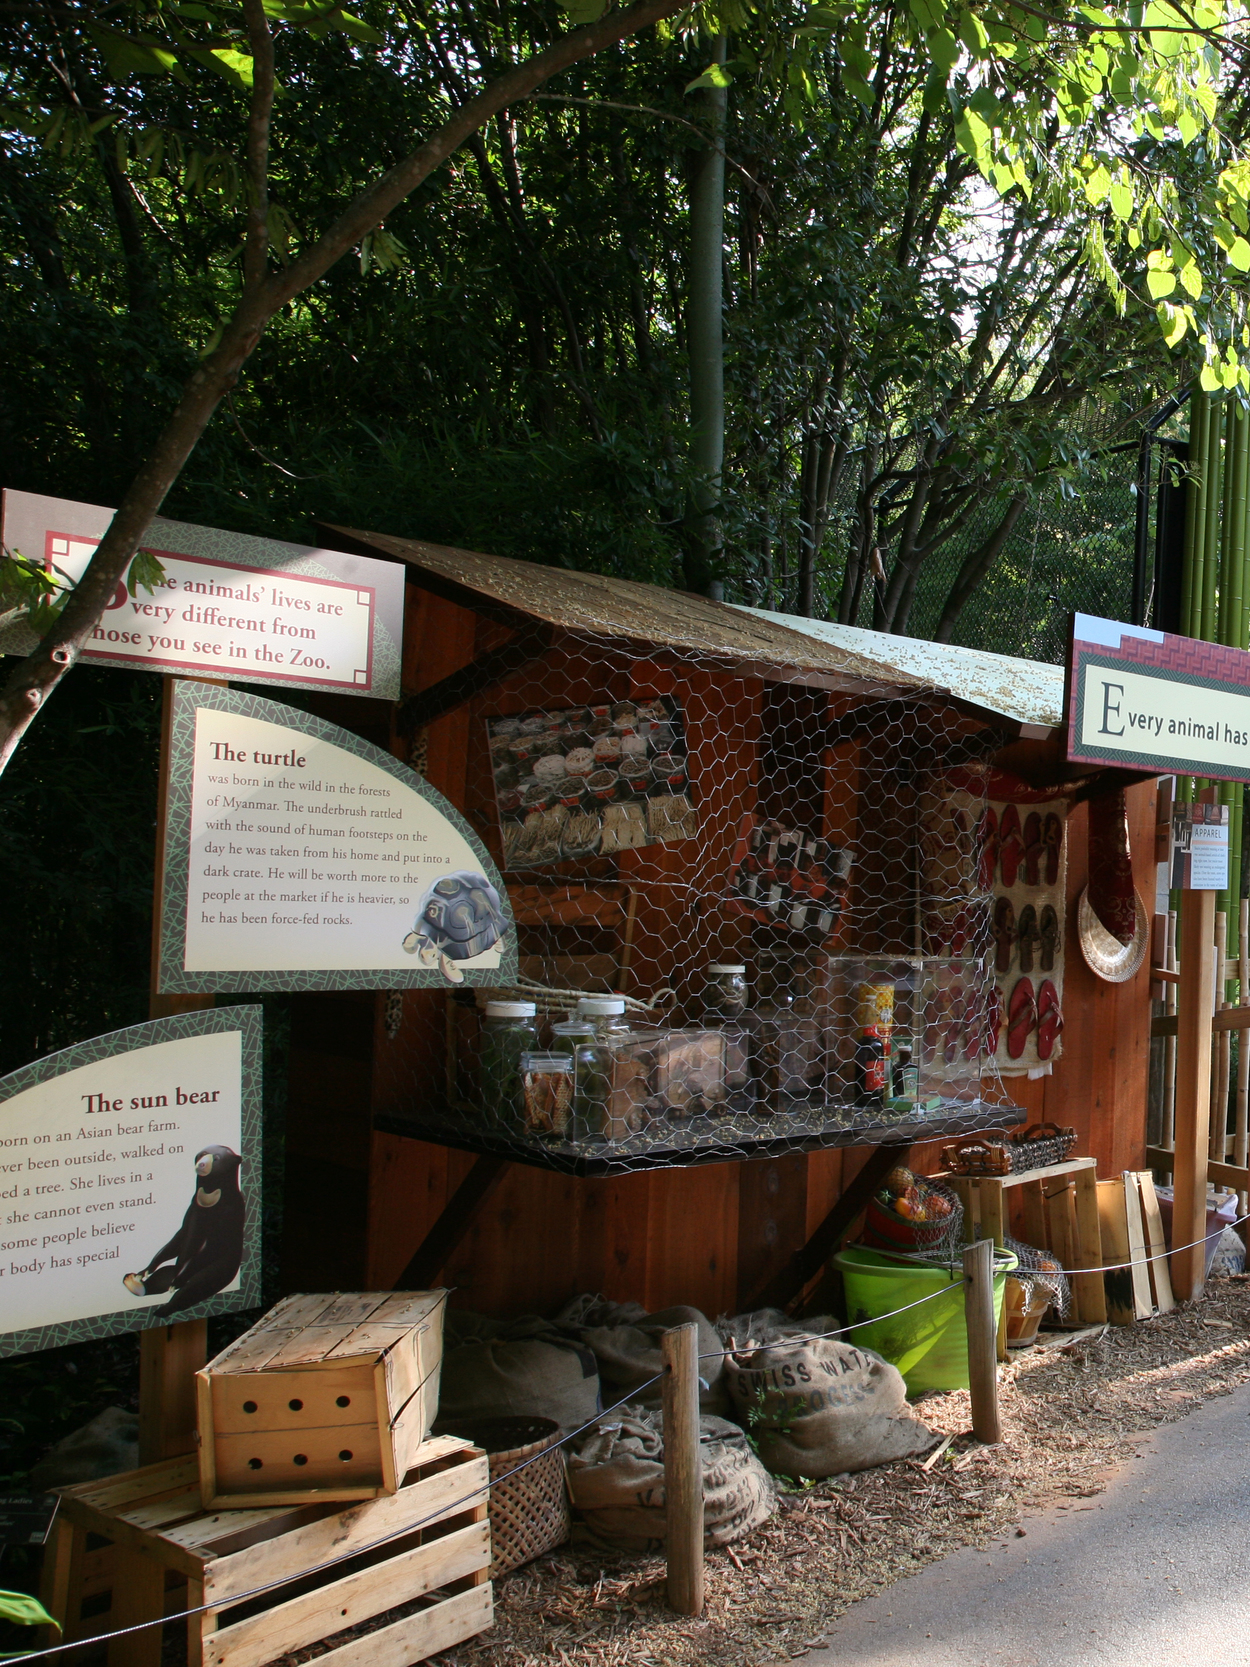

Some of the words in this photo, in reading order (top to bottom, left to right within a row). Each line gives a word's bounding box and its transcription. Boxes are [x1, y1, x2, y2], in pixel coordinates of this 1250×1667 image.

[272, 589, 310, 611] lives
[317, 603, 342, 616] are
[131, 601, 176, 624] very
[182, 604, 266, 632] different
[272, 617, 315, 639] from
[92, 624, 142, 645] hose
[148, 634, 186, 653] you
[193, 642, 221, 655] see
[229, 641, 247, 658] in
[255, 644, 283, 663] the
[290, 649, 330, 669] Zoo.
[1098, 682, 1163, 736] Every
[1168, 718, 1219, 741] animal
[1225, 724, 1247, 745] has
[209, 741, 247, 763] The
[252, 749, 307, 768] turtle
[207, 775, 229, 785] was
[232, 773, 260, 787] born
[263, 776, 275, 788] in
[278, 777, 296, 790] the
[298, 779, 322, 792] wild
[325, 781, 336, 793] in
[339, 782, 356, 795] the
[358, 783, 391, 798] forests
[206, 794, 221, 807] of
[222, 795, 280, 812] Myanmar.
[283, 800, 305, 813] The
[307, 802, 367, 817] underbrush
[370, 807, 403, 820] rattled
[205, 818, 232, 831] with
[235, 819, 254, 832] the
[256, 822, 291, 835] sound
[294, 823, 308, 835] of
[308, 823, 346, 838] human
[348, 826, 394, 843] footsteps
[396, 833, 409, 841] on
[412, 830, 428, 842] the
[1195, 828, 1221, 838] APPAREL
[204, 840, 226, 857] day
[228, 841, 243, 855] he
[245, 847, 267, 856] was
[269, 844, 300, 857] taken
[303, 845, 329, 859] from
[331, 847, 348, 860] his
[350, 848, 380, 861] home
[381, 850, 400, 862] and
[402, 854, 420, 866] put
[422, 855, 443, 864] into
[444, 856, 451, 864] a
[203, 864, 230, 877] dark
[232, 869, 264, 879] crate.
[268, 867, 285, 879] He
[287, 867, 308, 880] will
[311, 868, 324, 881] be
[326, 870, 358, 882] worth
[360, 874, 387, 883] more
[389, 875, 400, 883] to
[403, 872, 419, 884] the
[201, 888, 241, 904] people
[243, 892, 256, 901] at
[258, 889, 277, 902] the
[279, 890, 317, 903] market
[320, 890, 331, 903] if
[331, 891, 344, 903] he
[346, 892, 355, 904] is
[358, 892, 396, 905] heavier,
[398, 897, 410, 905] so
[201, 910, 216, 924] he
[219, 911, 238, 924] has
[241, 911, 268, 924] been
[271, 911, 319, 925] force-fed
[322, 913, 353, 925] rocks.
[80, 1092, 124, 1114] The
[130, 1095, 169, 1110] sun
[175, 1086, 221, 1106] bear
[33, 1134, 51, 1145] on
[55, 1132, 72, 1142] an
[75, 1126, 113, 1140] Asian
[117, 1123, 145, 1136] bear
[148, 1119, 180, 1133] farm.
[27, 1157, 60, 1171] been
[64, 1149, 116, 1166] outside,
[120, 1144, 165, 1159] walked
[168, 1145, 184, 1154] on
[22, 1187, 31, 1197] a
[35, 1184, 65, 1195] tree.
[69, 1176, 94, 1191] She
[97, 1174, 126, 1187] lives
[130, 1171, 142, 1183] in
[146, 1172, 153, 1181] a
[6, 1210, 30, 1225] she
[33, 1206, 81, 1221] cannot
[85, 1201, 115, 1214] even
[118, 1192, 157, 1209] stand.
[0, 1237, 38, 1251] some
[42, 1226, 87, 1249] people
[91, 1222, 136, 1237] believe
[10, 1258, 46, 1275] body
[50, 1255, 72, 1269] has
[76, 1245, 120, 1268] special
[737, 1362, 812, 1397] SWISS
